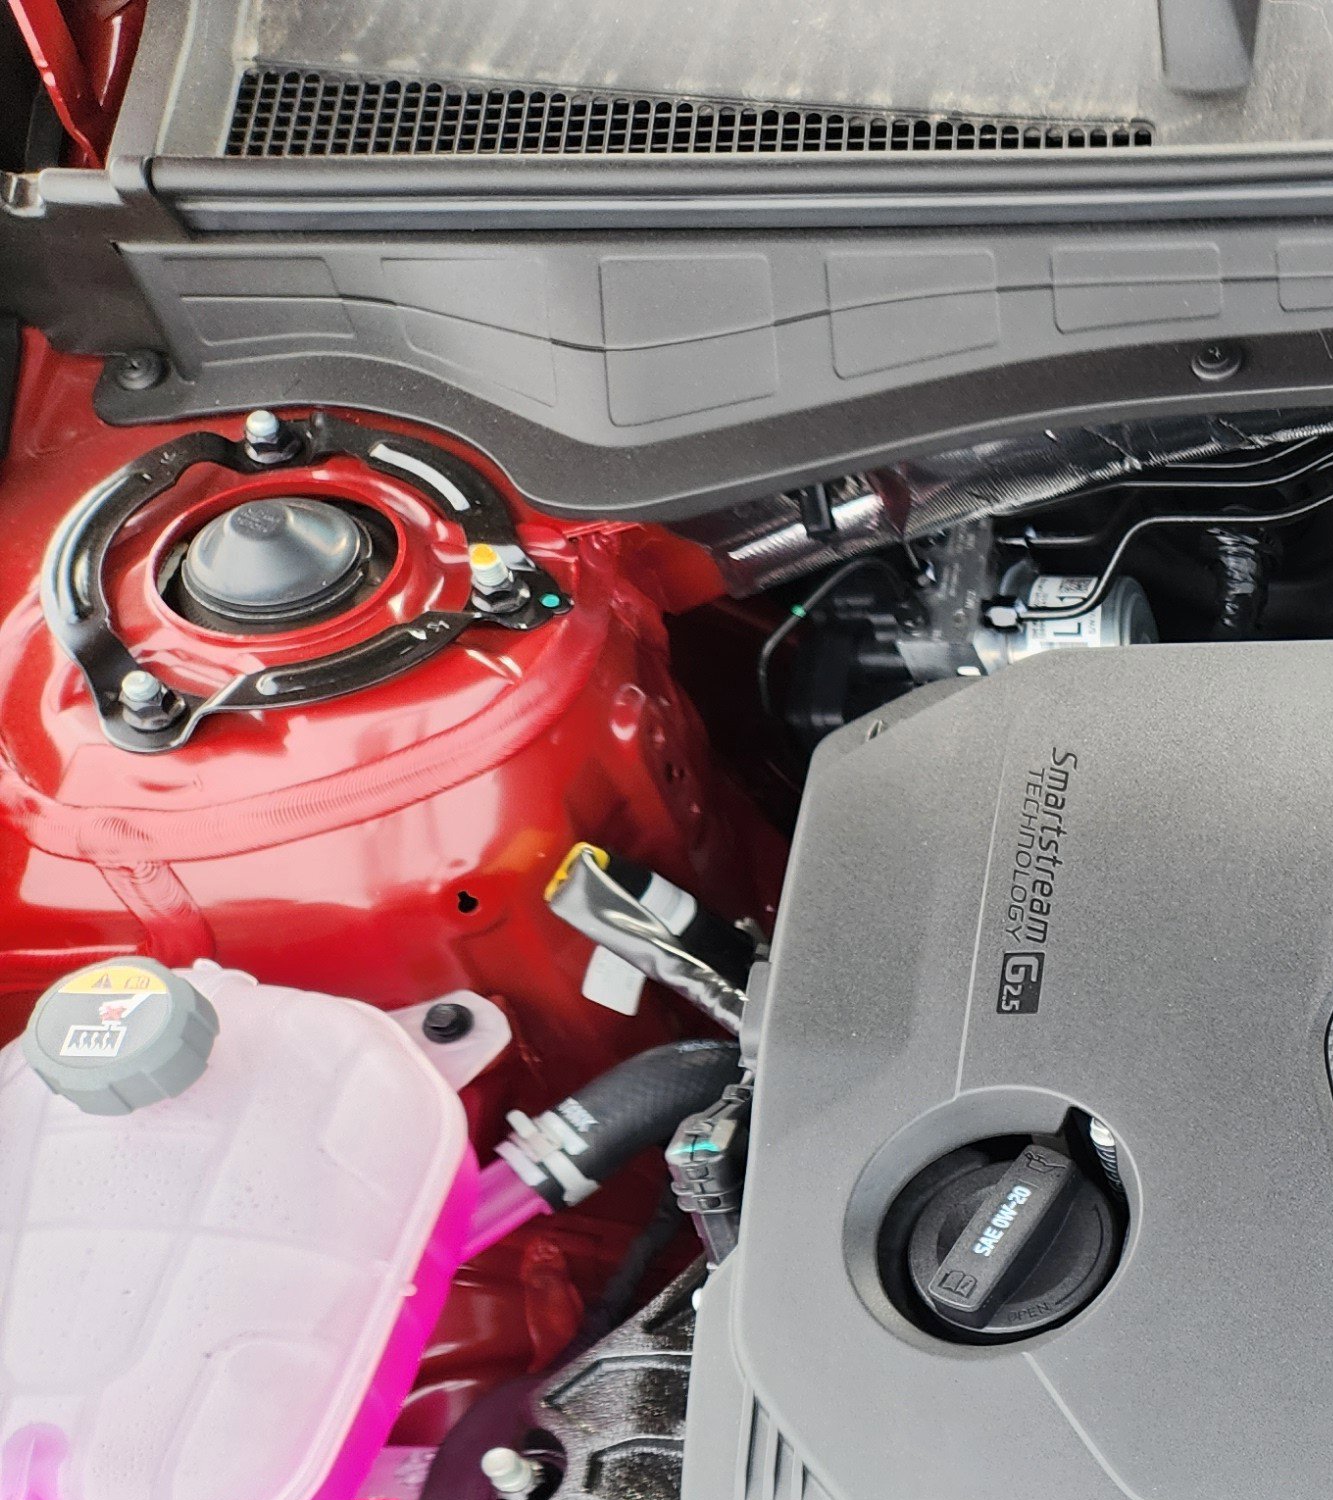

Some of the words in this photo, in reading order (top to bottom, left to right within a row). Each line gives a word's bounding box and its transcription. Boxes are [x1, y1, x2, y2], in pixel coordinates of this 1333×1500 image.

[1005, 767, 1045, 943] TECHNOLOGY
[1025, 747, 1078, 944] Smartstream
[974, 1225, 1005, 1258] SAE
[991, 1185, 1032, 1229] 0W-20
[1006, 1302, 1050, 1323] OPEN
